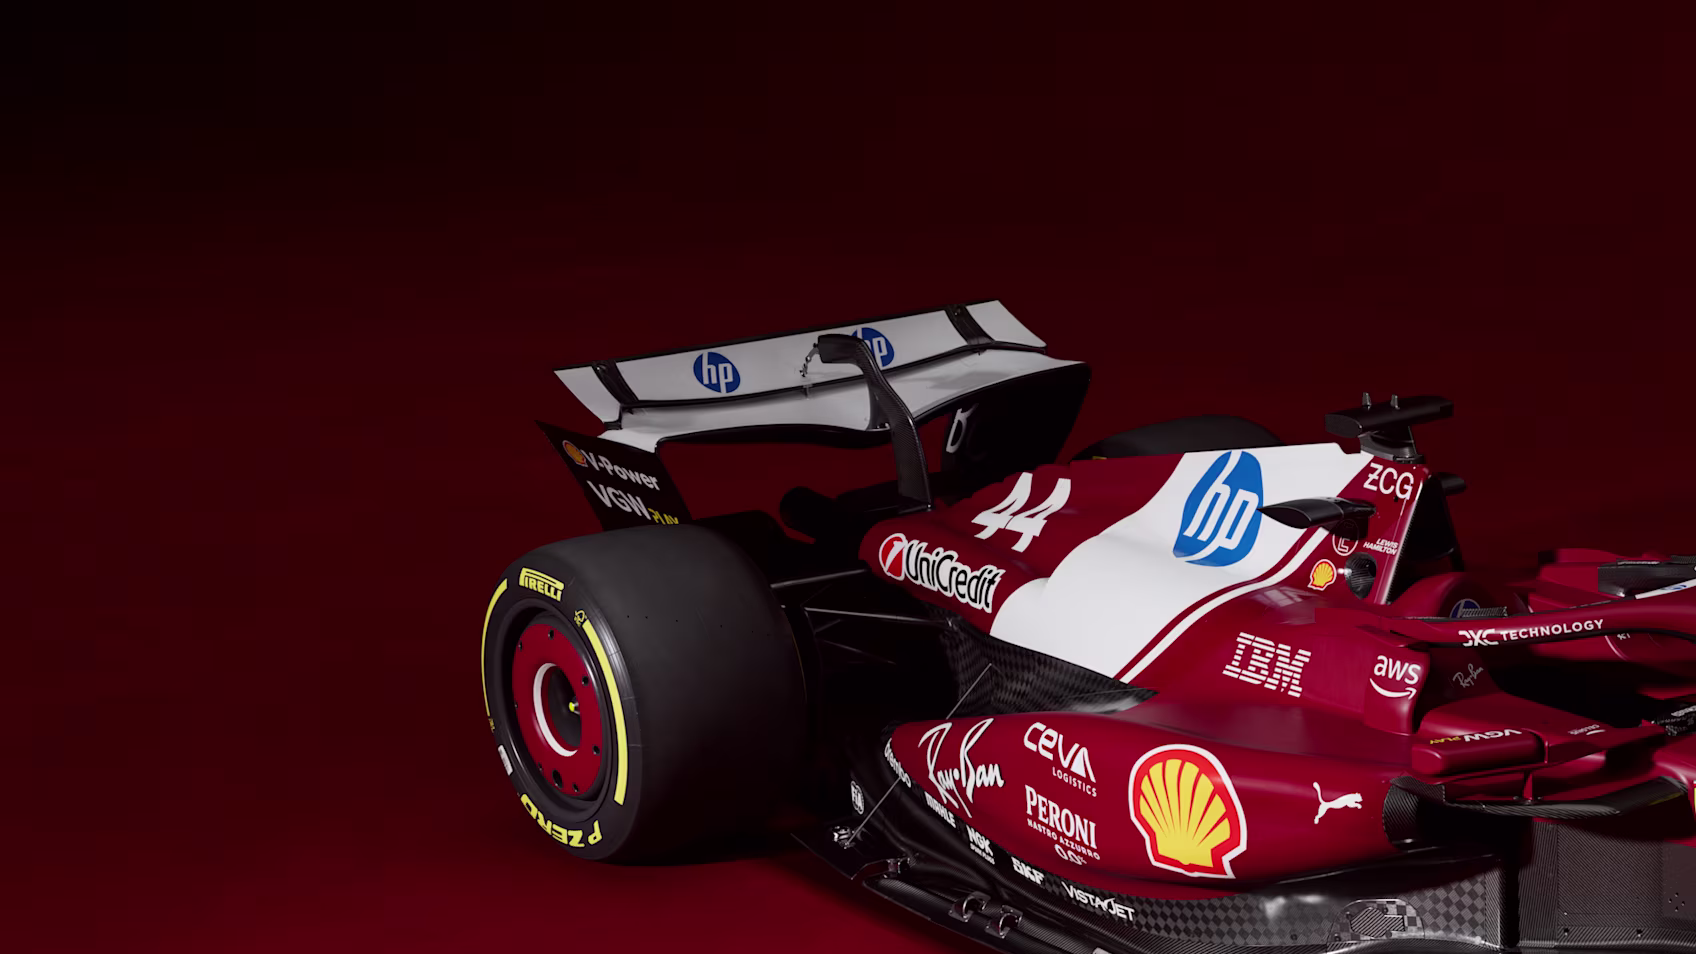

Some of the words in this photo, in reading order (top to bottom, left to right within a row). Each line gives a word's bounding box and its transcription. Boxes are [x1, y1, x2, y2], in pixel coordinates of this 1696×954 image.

[697, 352, 738, 393] hp
[580, 449, 660, 491] V-Power
[1363, 462, 1415, 500] ZCG
[586, 480, 651, 520] VGW
[971, 472, 1071, 553] 44
[1178, 450, 1261, 564] hp
[519, 567, 565, 602] PIRELLI
[905, 540, 1003, 611] UniCredit
[1500, 618, 1604, 642] TECHNOLOGY
[1222, 631, 1312, 698] IBM
[1374, 653, 1421, 686] aws
[1052, 768, 1097, 797] LOGISTICS
[1025, 784, 1097, 849] PERONI
[1027, 818, 1058, 840] NASTRO
[1059, 836, 1100, 860] AZZURRO
[1011, 856, 1045, 885] SKF
